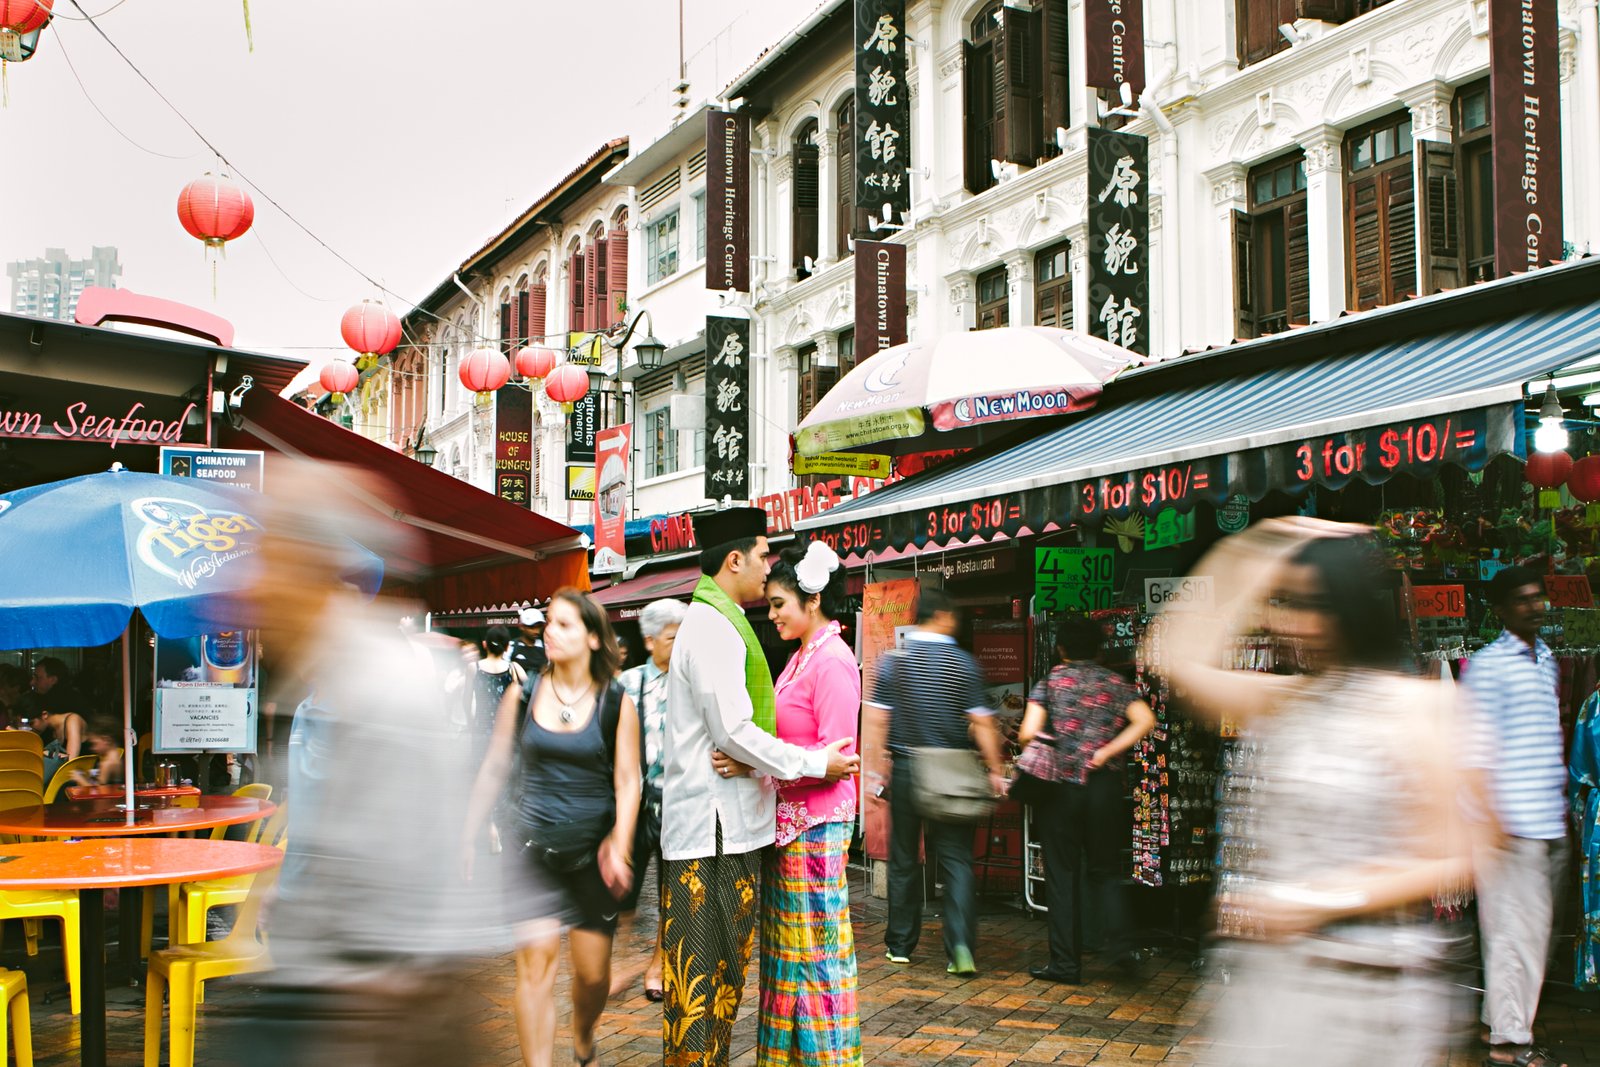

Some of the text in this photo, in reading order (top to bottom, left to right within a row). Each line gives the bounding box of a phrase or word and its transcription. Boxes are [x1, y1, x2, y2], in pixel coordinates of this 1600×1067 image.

[1112, 20, 1126, 83] Centre
[1522, 94, 1540, 205] Heritage
[722, 117, 736, 287] Chinatown Heritage Centre
[877, 249, 890, 331] Chinatown
[53, 401, 198, 449] Seafood
[500, 431, 529, 443] HOUSE
[574, 401, 586, 444] Synergy
[195, 455, 246, 466] CHINATOWN
[496, 459, 531, 471] KUNGFU
[508, 446, 520, 457] OF
[1296, 445, 1315, 481] 3
[1322, 440, 1367, 477] for
[196, 468, 237, 479] SEAFOOD
[570, 489, 596, 499] Niko
[750, 479, 842, 533] ERITAGE
[1083, 484, 1096, 514] 3
[1102, 479, 1135, 510] for
[149, 513, 258, 557] Tiger
[927, 511, 937, 537] 3
[942, 508, 967, 534] for
[957, 556, 995, 574] Restaurant
[1037, 550, 1064, 582] 4
[1082, 553, 1113, 583] $10
[1041, 584, 1112, 611] 3 $10
[1150, 580, 1207, 604] 6 FOR $10
[1435, 590, 1462, 614] $10
